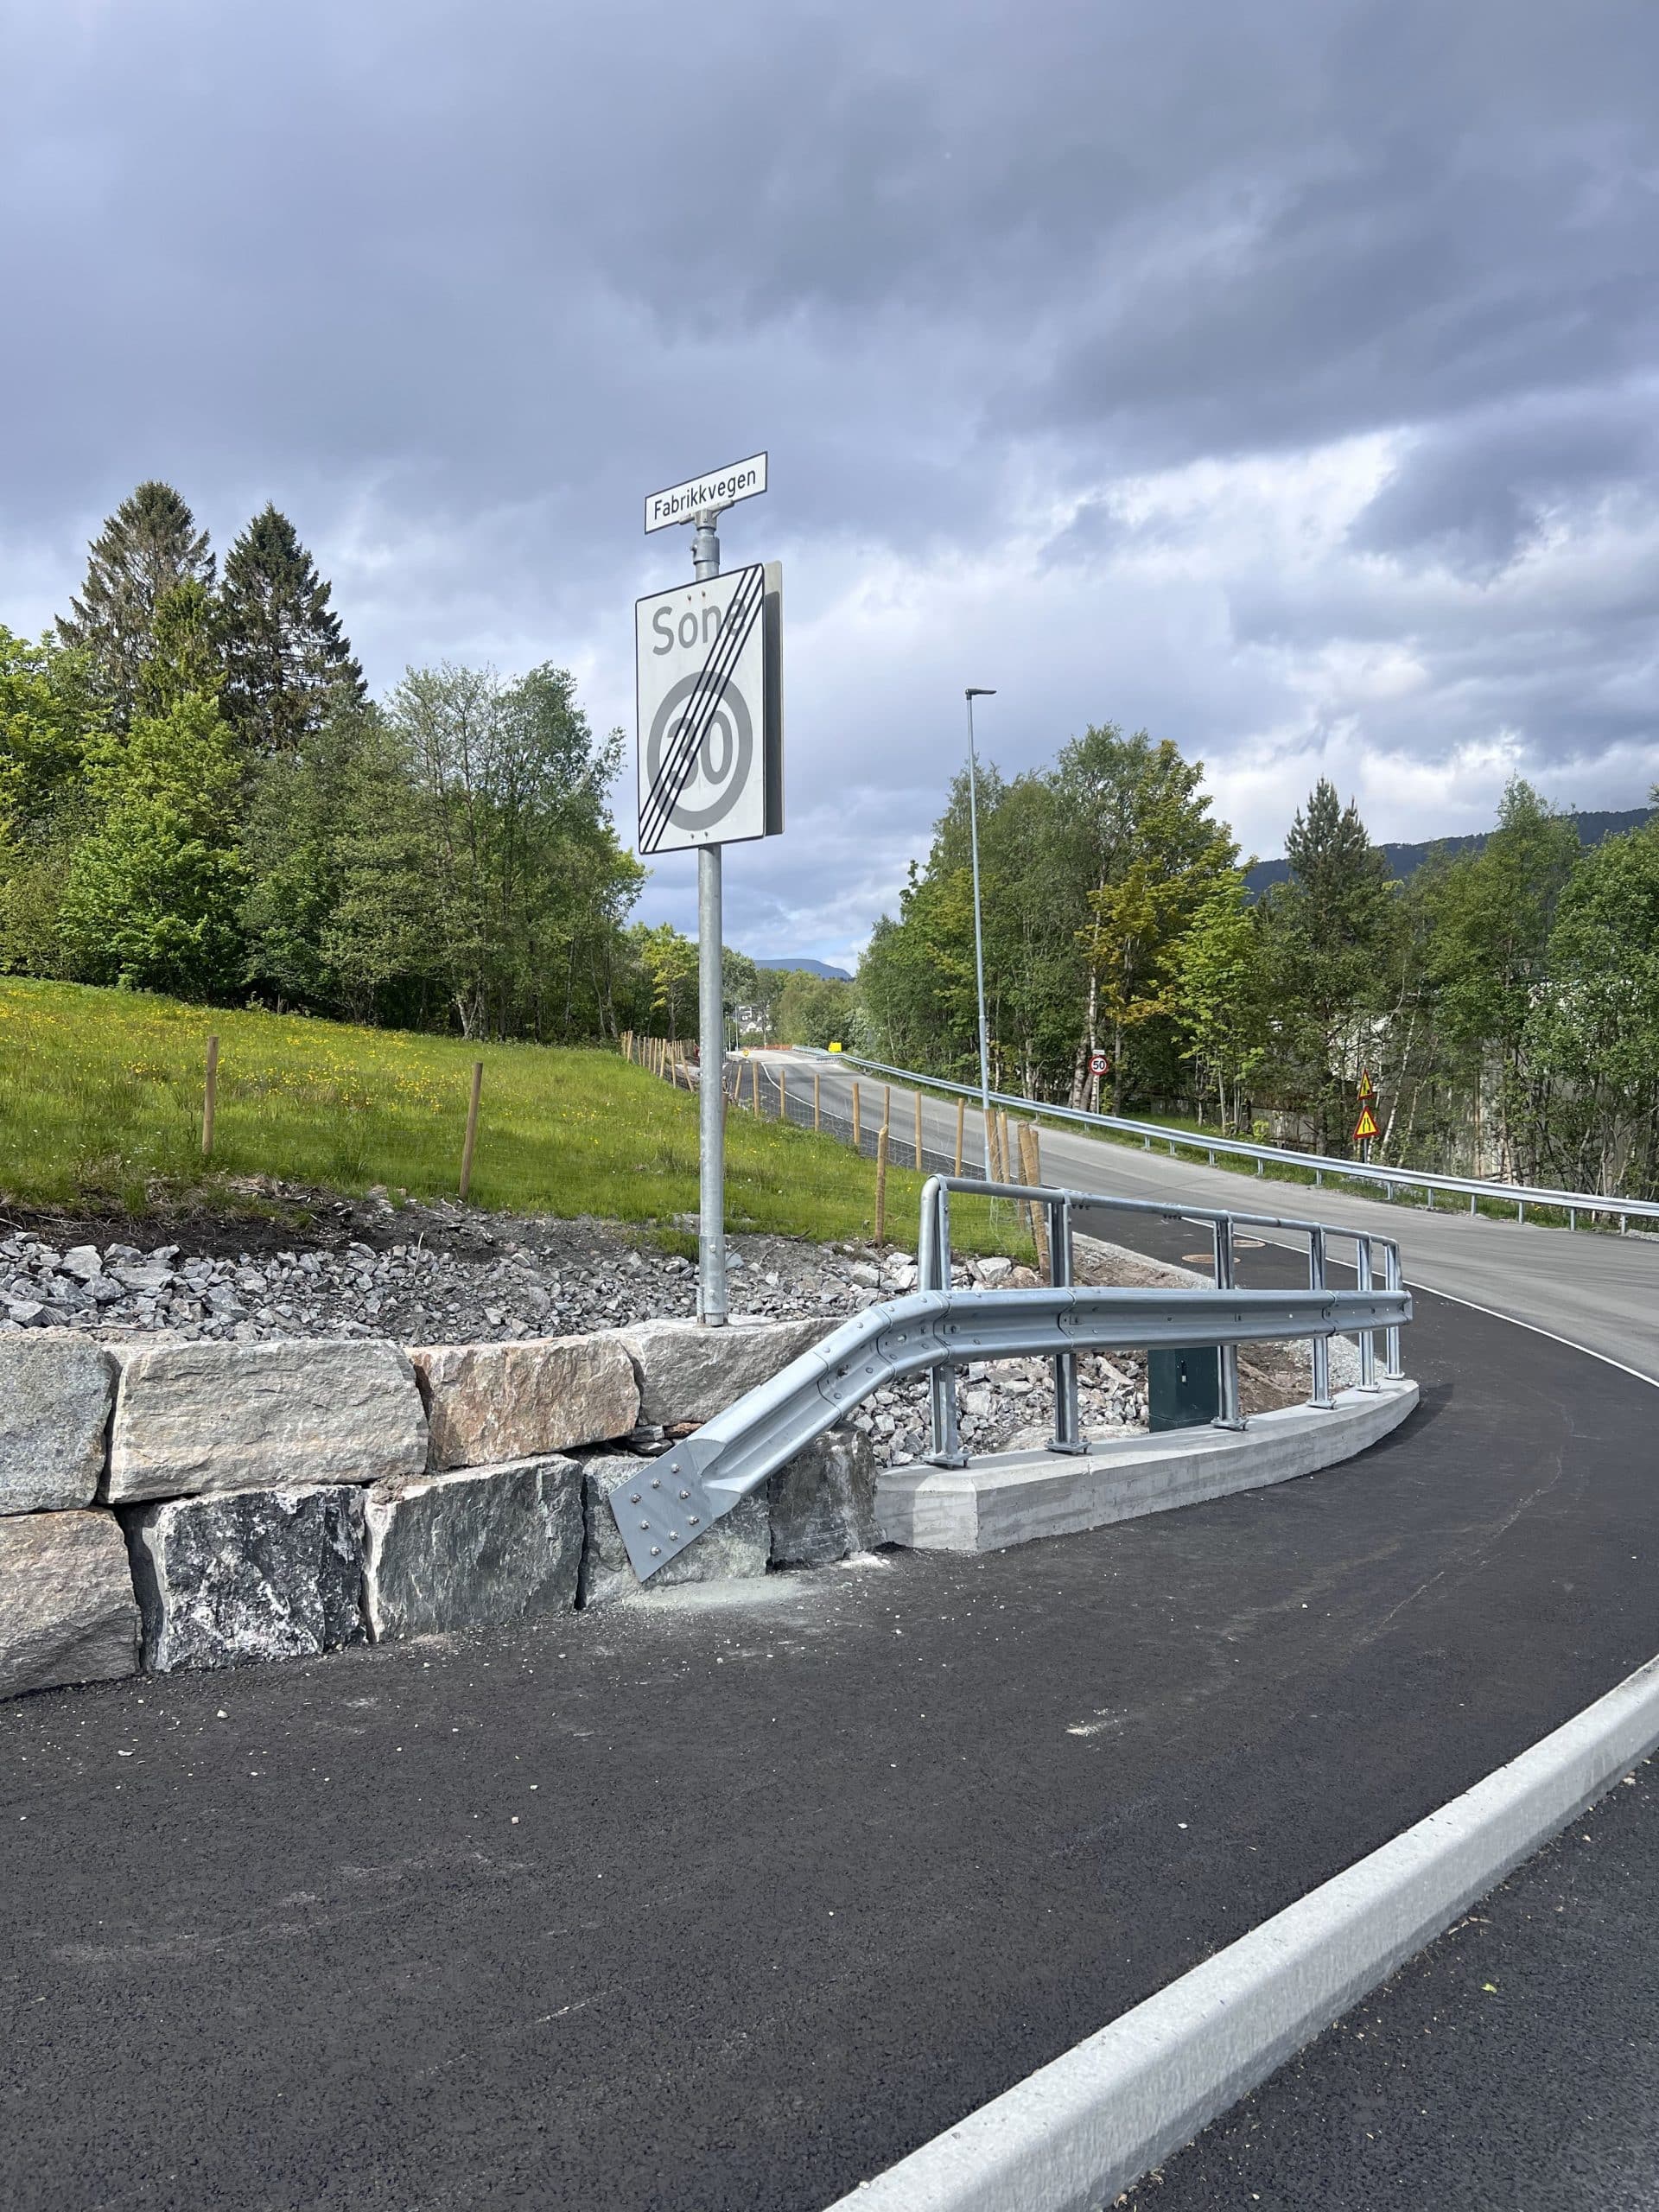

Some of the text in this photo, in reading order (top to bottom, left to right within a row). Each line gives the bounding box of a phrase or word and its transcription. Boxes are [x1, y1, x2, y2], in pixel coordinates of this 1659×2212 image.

[654, 469, 756, 520] Fabrikkvegen
[652, 598, 746, 656] Sone
[666, 710, 734, 791] 30
[1093, 1060, 1105, 1070] 50
